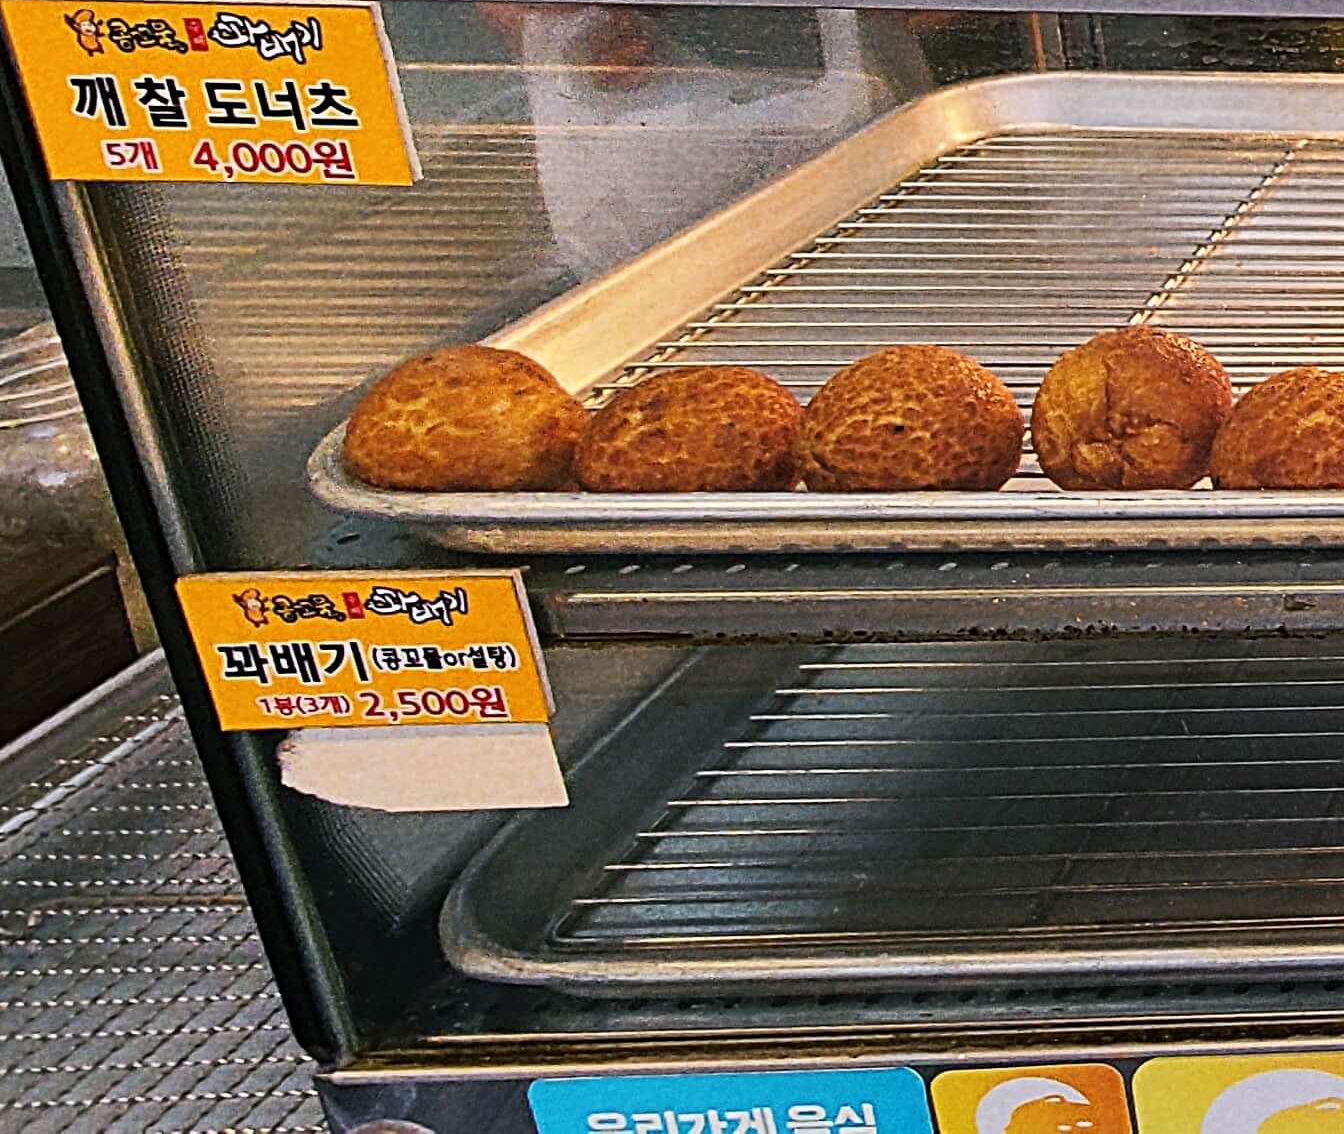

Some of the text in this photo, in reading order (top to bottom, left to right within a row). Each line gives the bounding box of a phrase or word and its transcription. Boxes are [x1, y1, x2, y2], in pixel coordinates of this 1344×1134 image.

[204, 80, 360, 131] 도너츠
[106, 141, 356, 179] 5개 4,000원
[217, 640, 373, 684] 꽈배기
[259, 687, 511, 723] 1봉(3개) 2,500원
